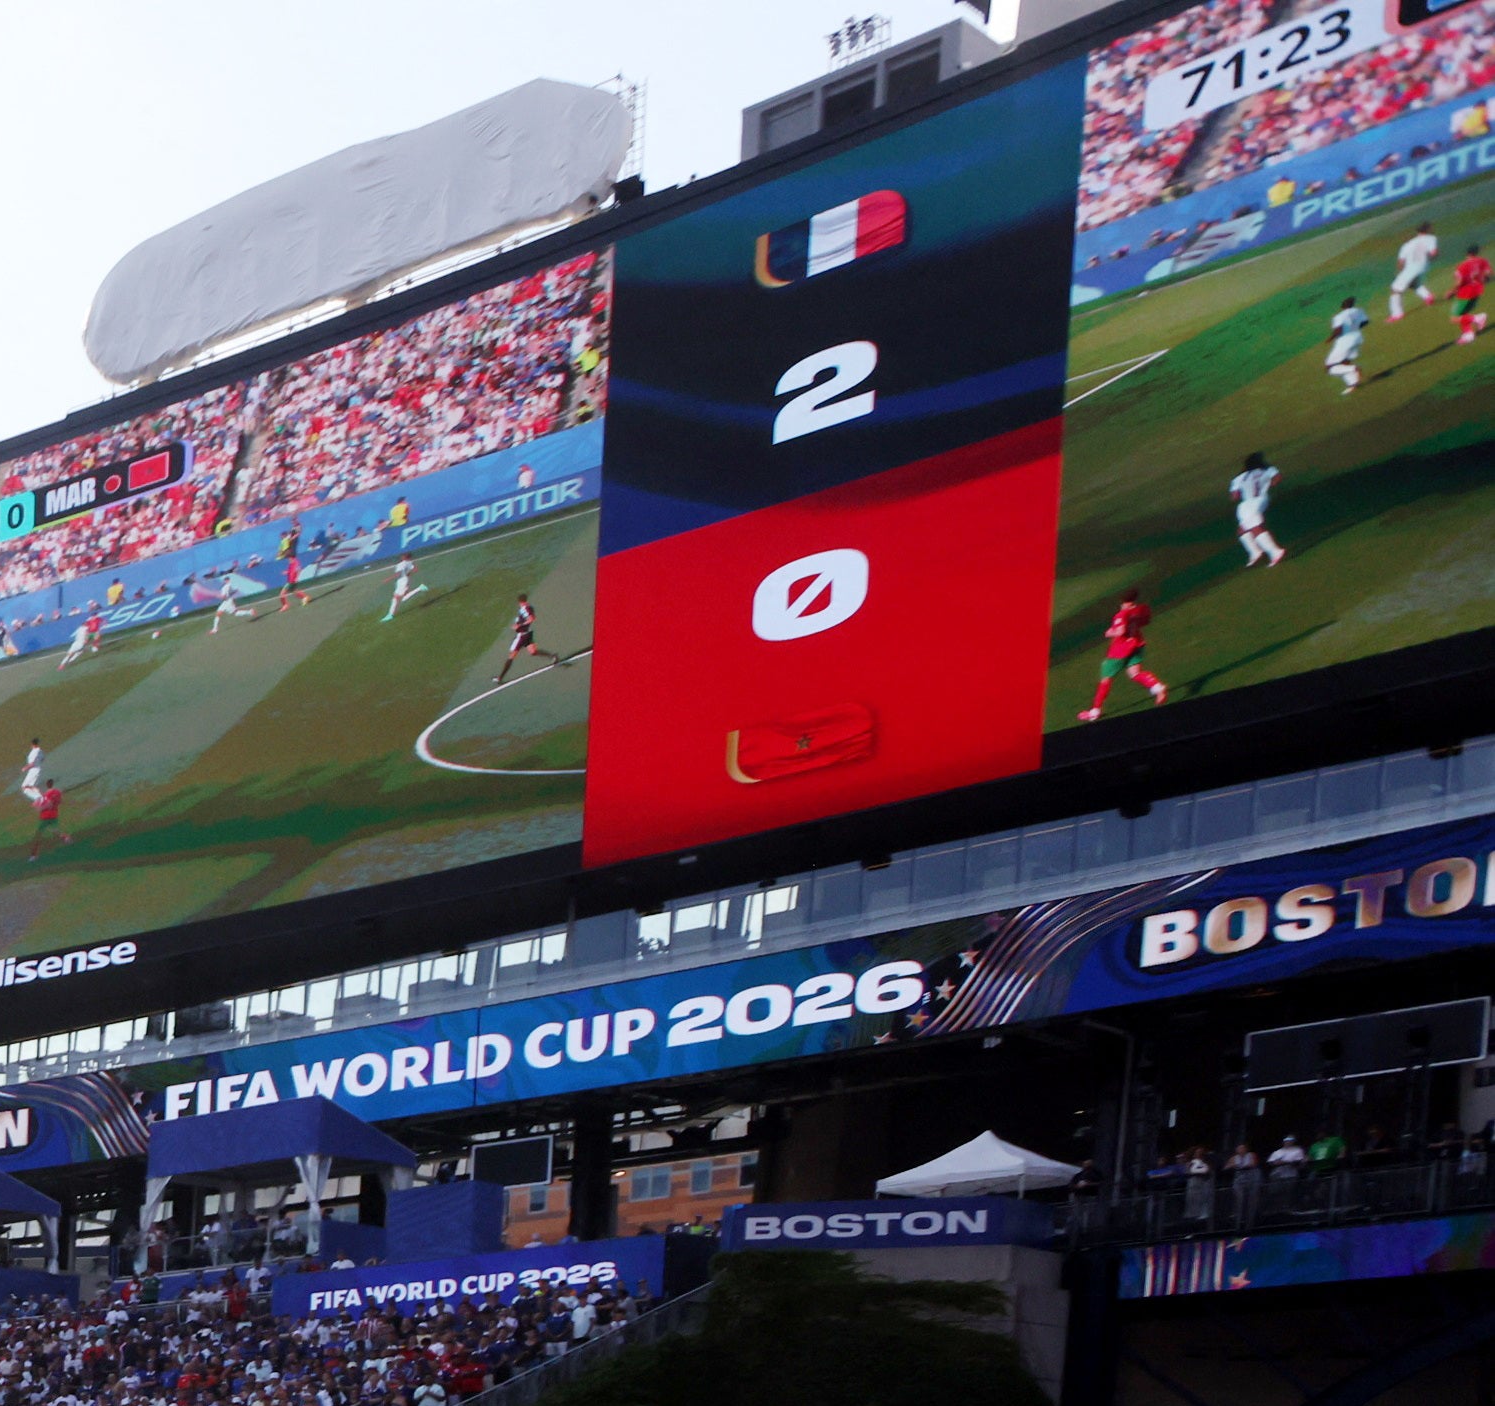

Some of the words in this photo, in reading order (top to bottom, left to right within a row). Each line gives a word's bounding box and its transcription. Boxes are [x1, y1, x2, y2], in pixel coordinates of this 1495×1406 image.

[1182, 9, 1351, 108] 71:23
[772, 340, 878, 445] 2
[7, 503, 24, 529] 0
[45, 477, 97, 517] MAR
[401, 477, 584, 549] PREDATOR
[1140, 851, 1495, 968] BOSTO
[165, 1069, 280, 1121] FIFA
[291, 1032, 512, 1101] WORLD
[523, 1008, 656, 1069] CUP
[667, 960, 925, 1048] 2026
[744, 1209, 989, 1241] BOSTON
[310, 1288, 361, 1311] FIFA
[365, 1278, 458, 1305] WORLD
[461, 1272, 515, 1296] CUP
